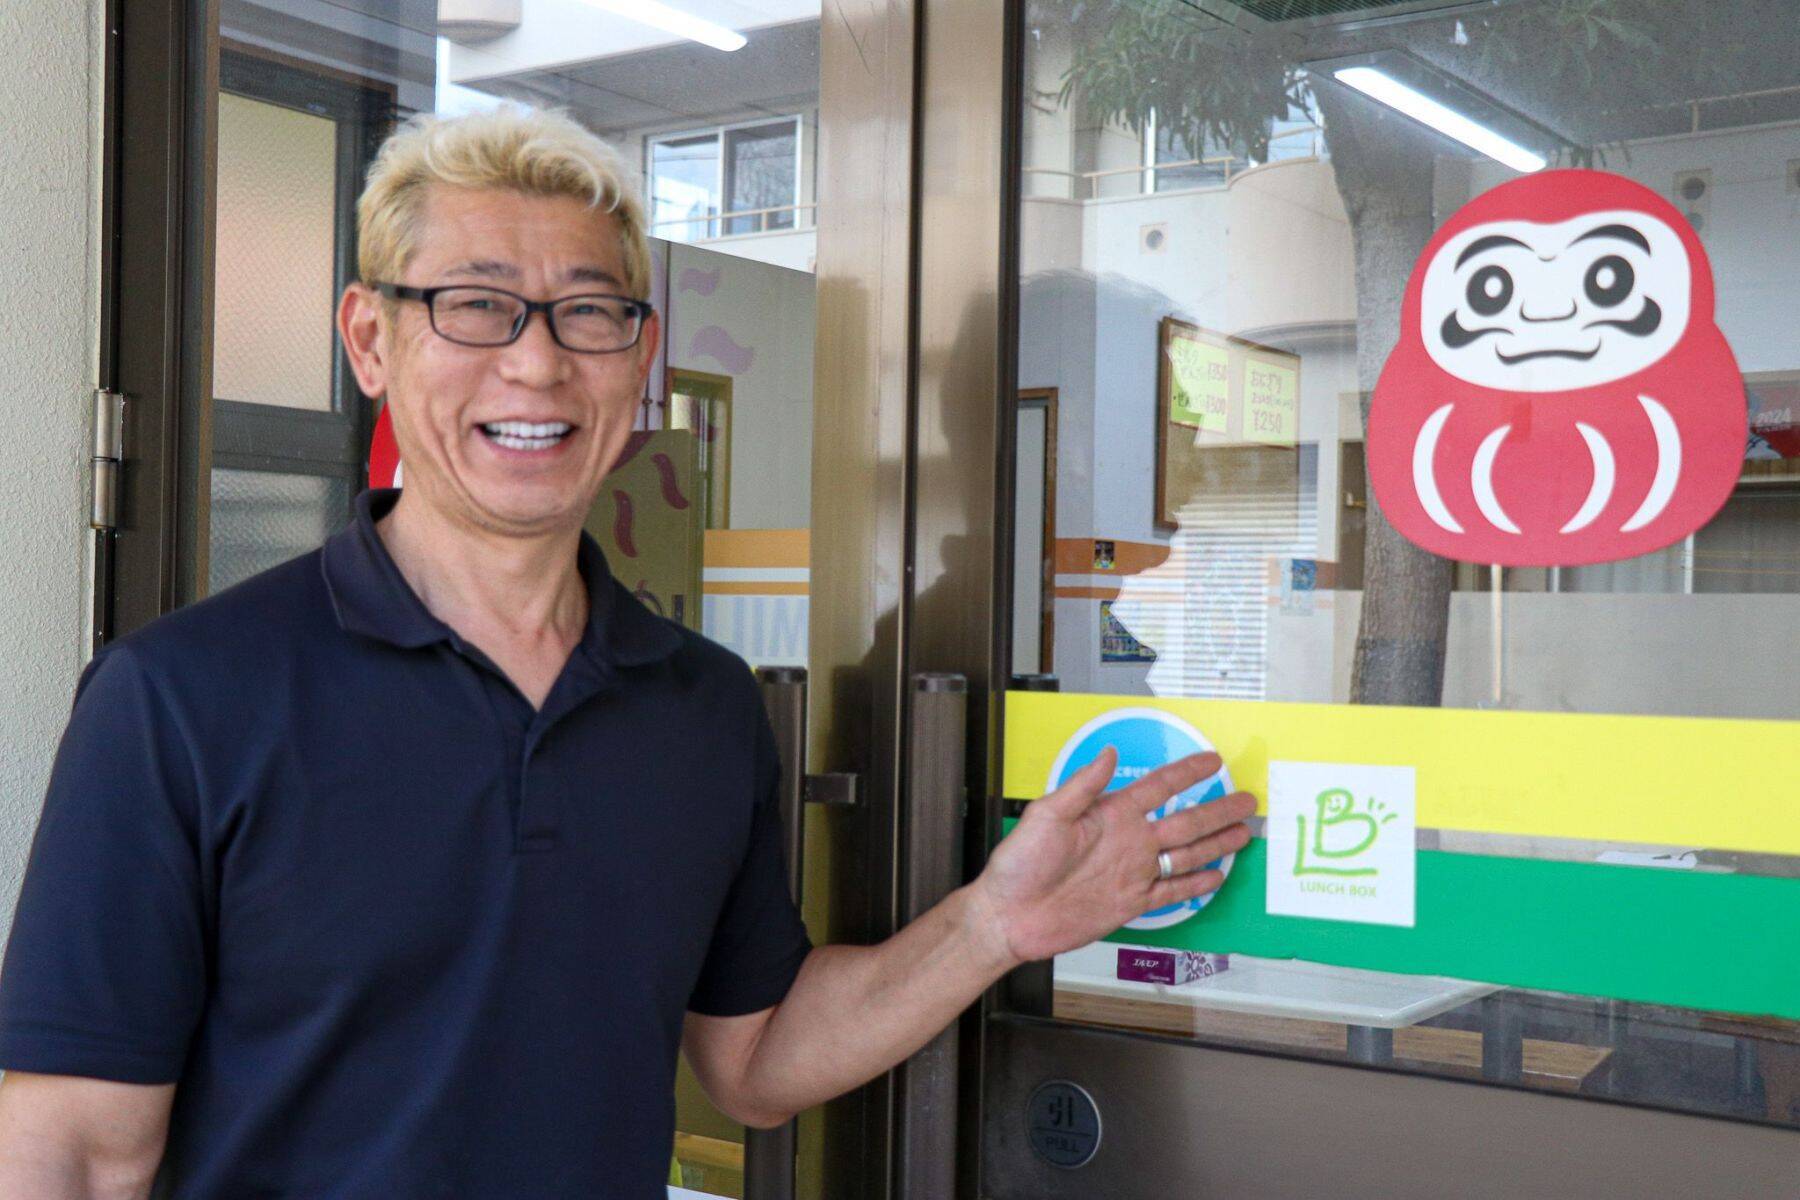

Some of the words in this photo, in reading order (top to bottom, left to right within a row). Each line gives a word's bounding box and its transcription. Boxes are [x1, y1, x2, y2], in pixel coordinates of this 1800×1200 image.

[1253, 410, 1282, 434] ¥250
[1300, 881, 1345, 895] LUNCH
[1349, 884, 1377, 898] BOX
[1048, 1095, 1074, 1127] 引
[1046, 1135, 1080, 1153] PULL
